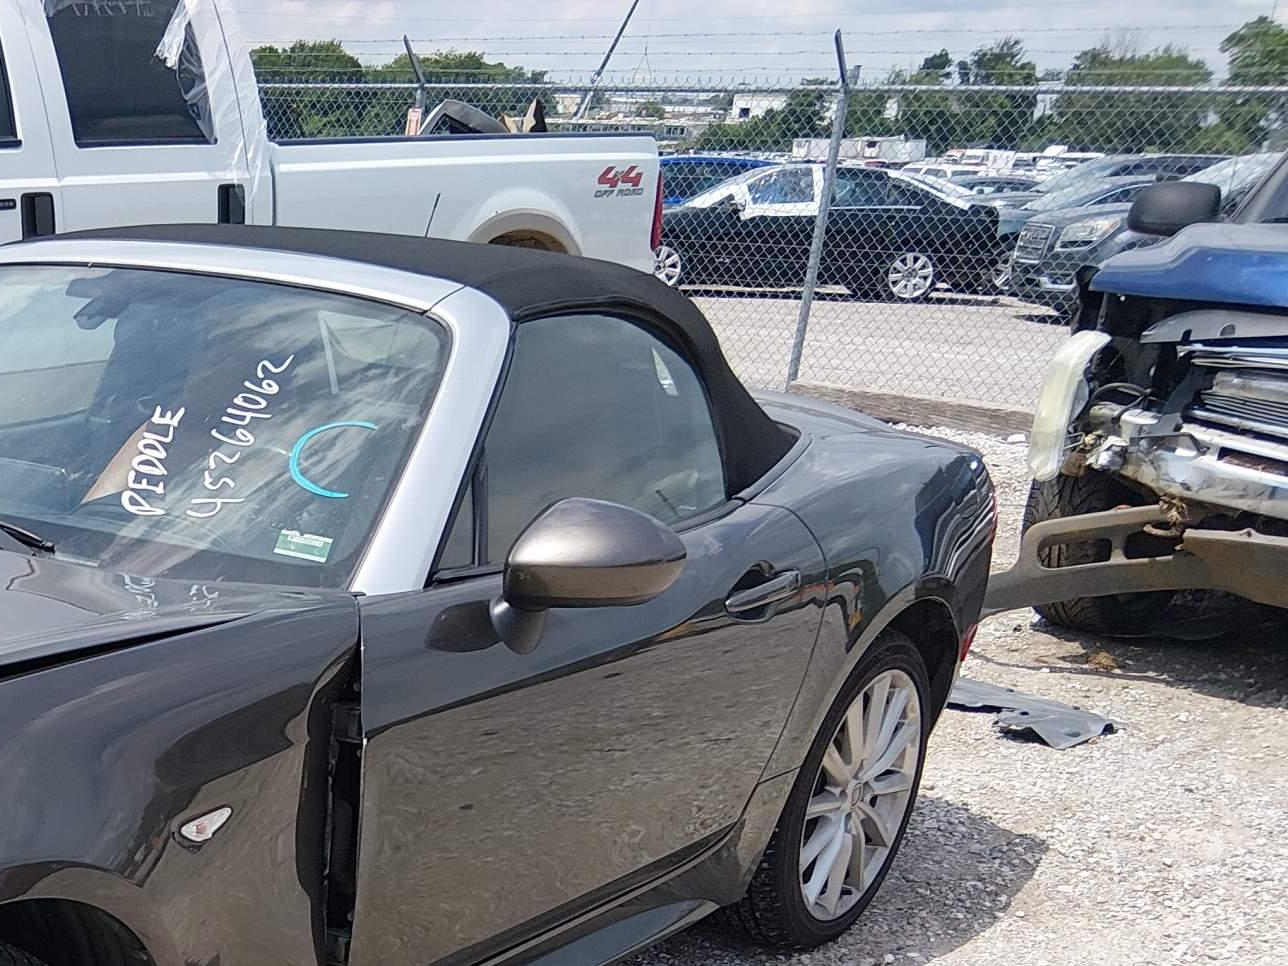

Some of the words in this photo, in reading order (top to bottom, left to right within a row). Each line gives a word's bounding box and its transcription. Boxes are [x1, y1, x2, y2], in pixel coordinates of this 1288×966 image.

[594, 189, 615, 198] OFF
[616, 187, 644, 197] ROAD
[120, 404, 186, 516] PEDDLE
[185, 354, 295, 518] 45264062
